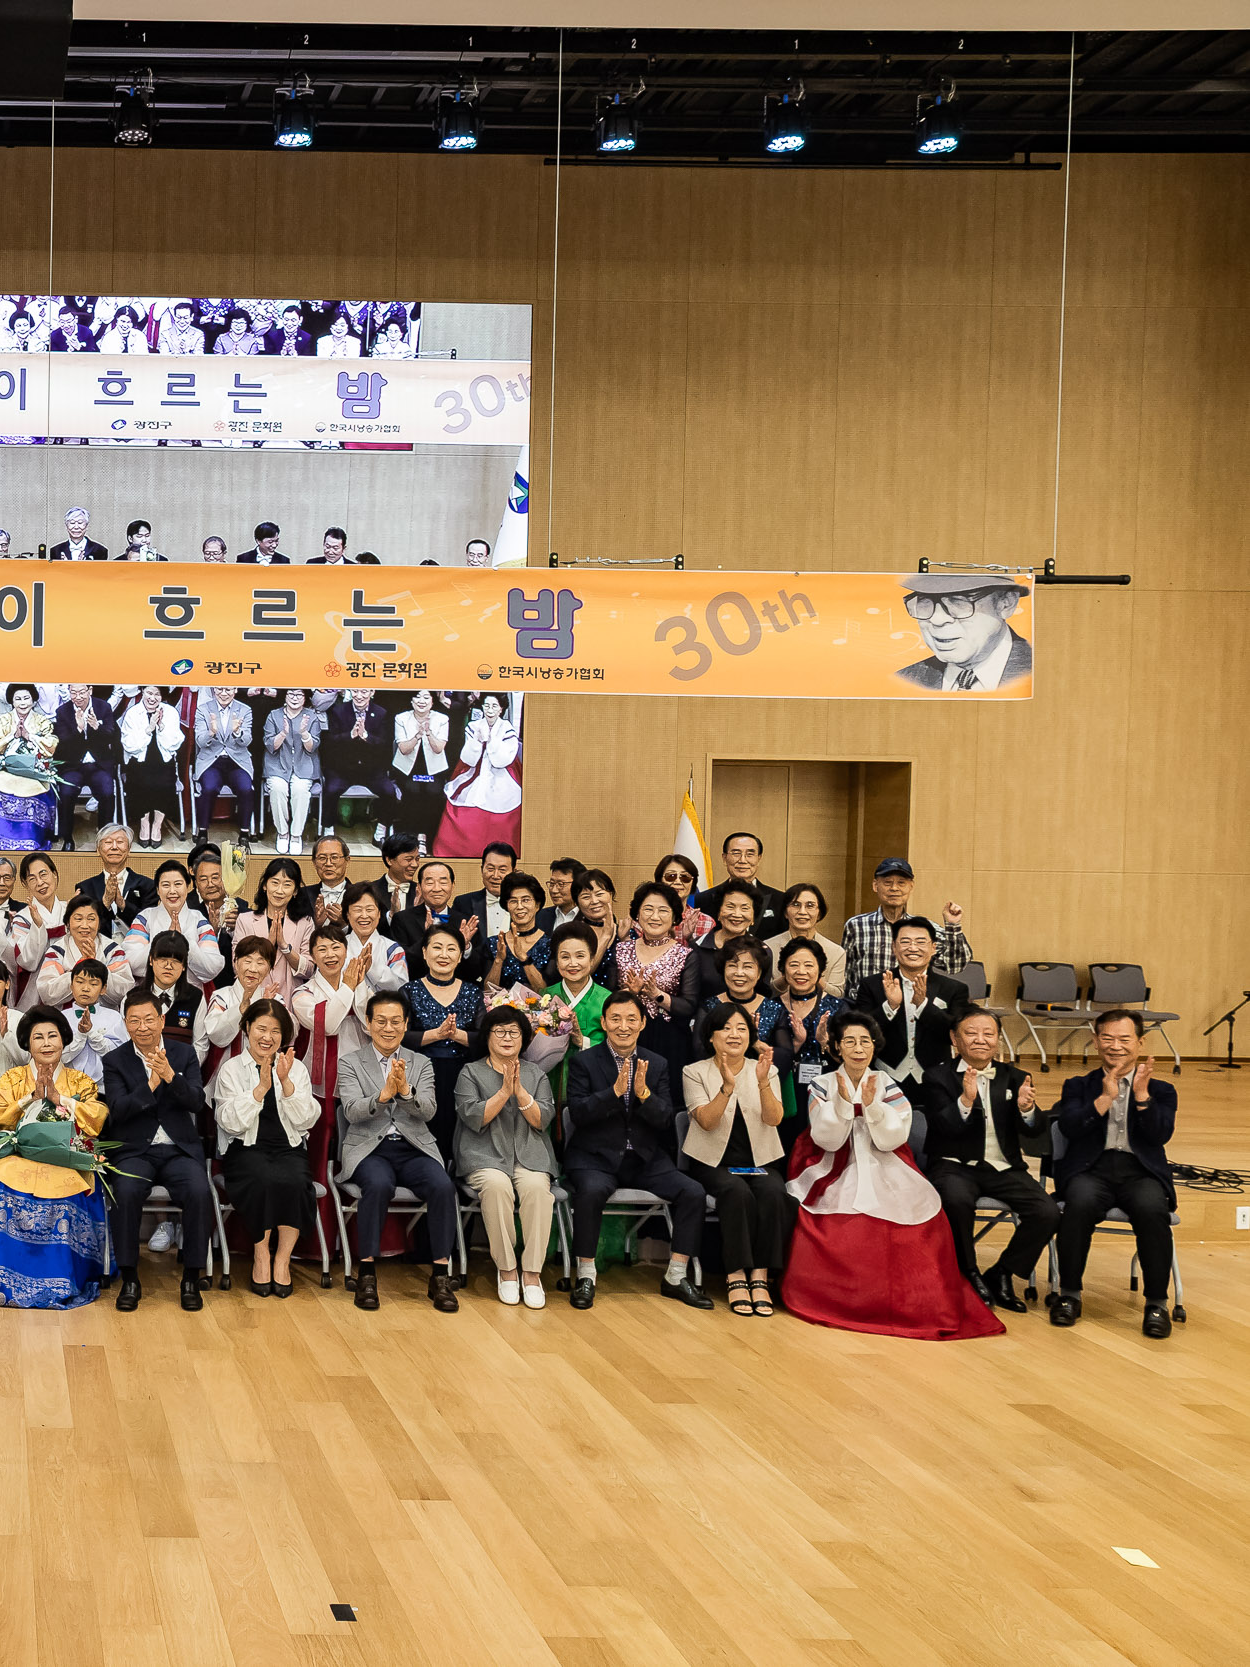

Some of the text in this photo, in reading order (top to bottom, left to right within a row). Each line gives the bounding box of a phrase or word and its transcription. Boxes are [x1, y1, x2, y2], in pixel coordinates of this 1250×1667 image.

[142, 32, 146, 43] 1
[303, 34, 309, 45] 2
[468, 36, 473, 47] 1
[631, 38, 637, 49] 2
[794, 39, 799, 50] 1
[958, 39, 964, 50] 2
[336, 370, 389, 420] 밤
[506, 587, 584, 661] 밤
[653, 588, 817, 682] 30th
[203, 661, 264, 676] 광진구
[344, 662, 429, 680] 광진 문화원
[497, 665, 606, 681] 한국시낭송가협회
